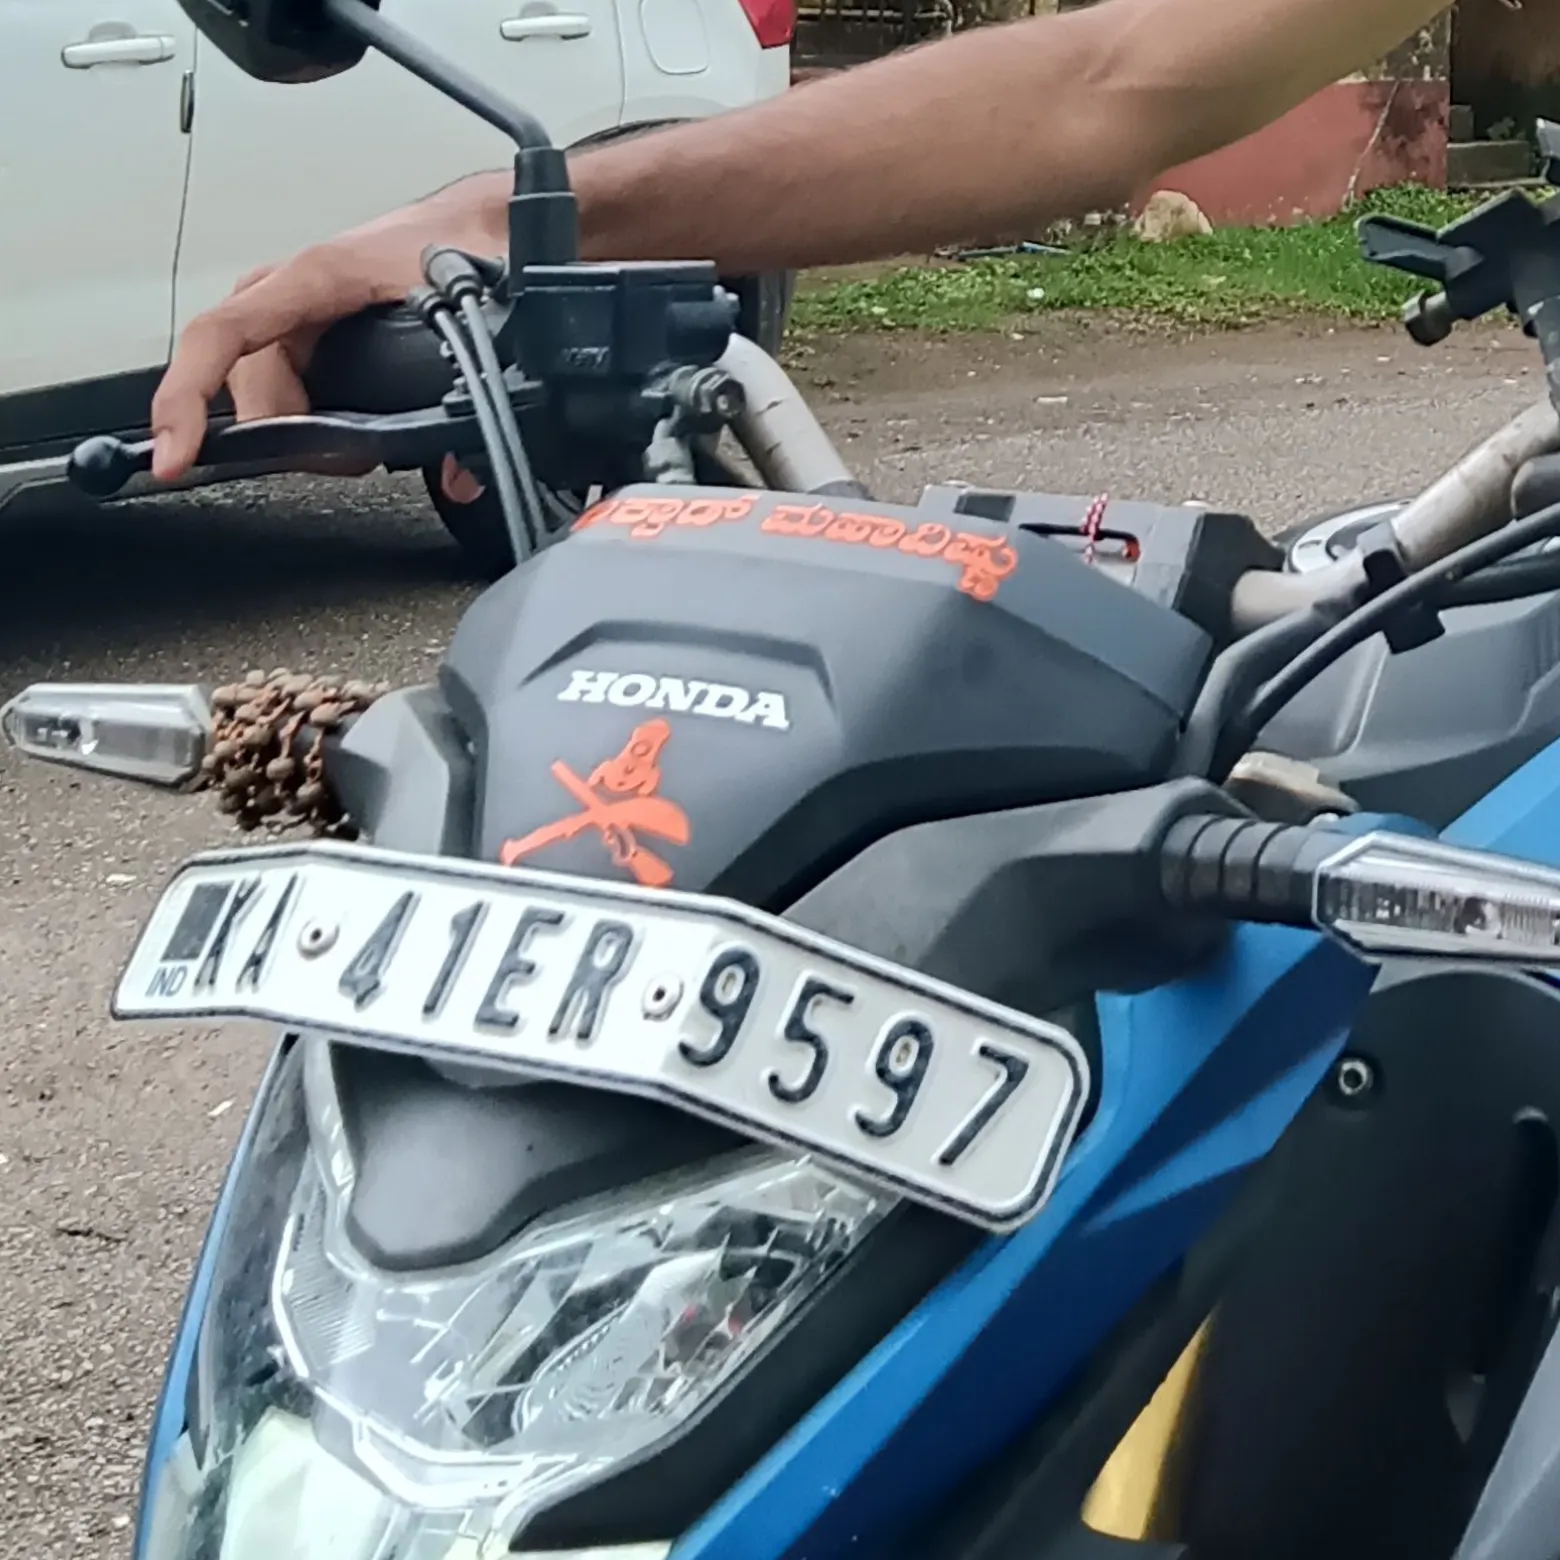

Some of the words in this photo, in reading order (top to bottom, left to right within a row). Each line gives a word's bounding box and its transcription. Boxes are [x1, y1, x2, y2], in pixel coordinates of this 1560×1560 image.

[557, 669, 790, 730] HONDA
[145, 965, 188, 997] IND
[193, 872, 298, 992] KA
[677, 943, 1030, 1167] 9597
